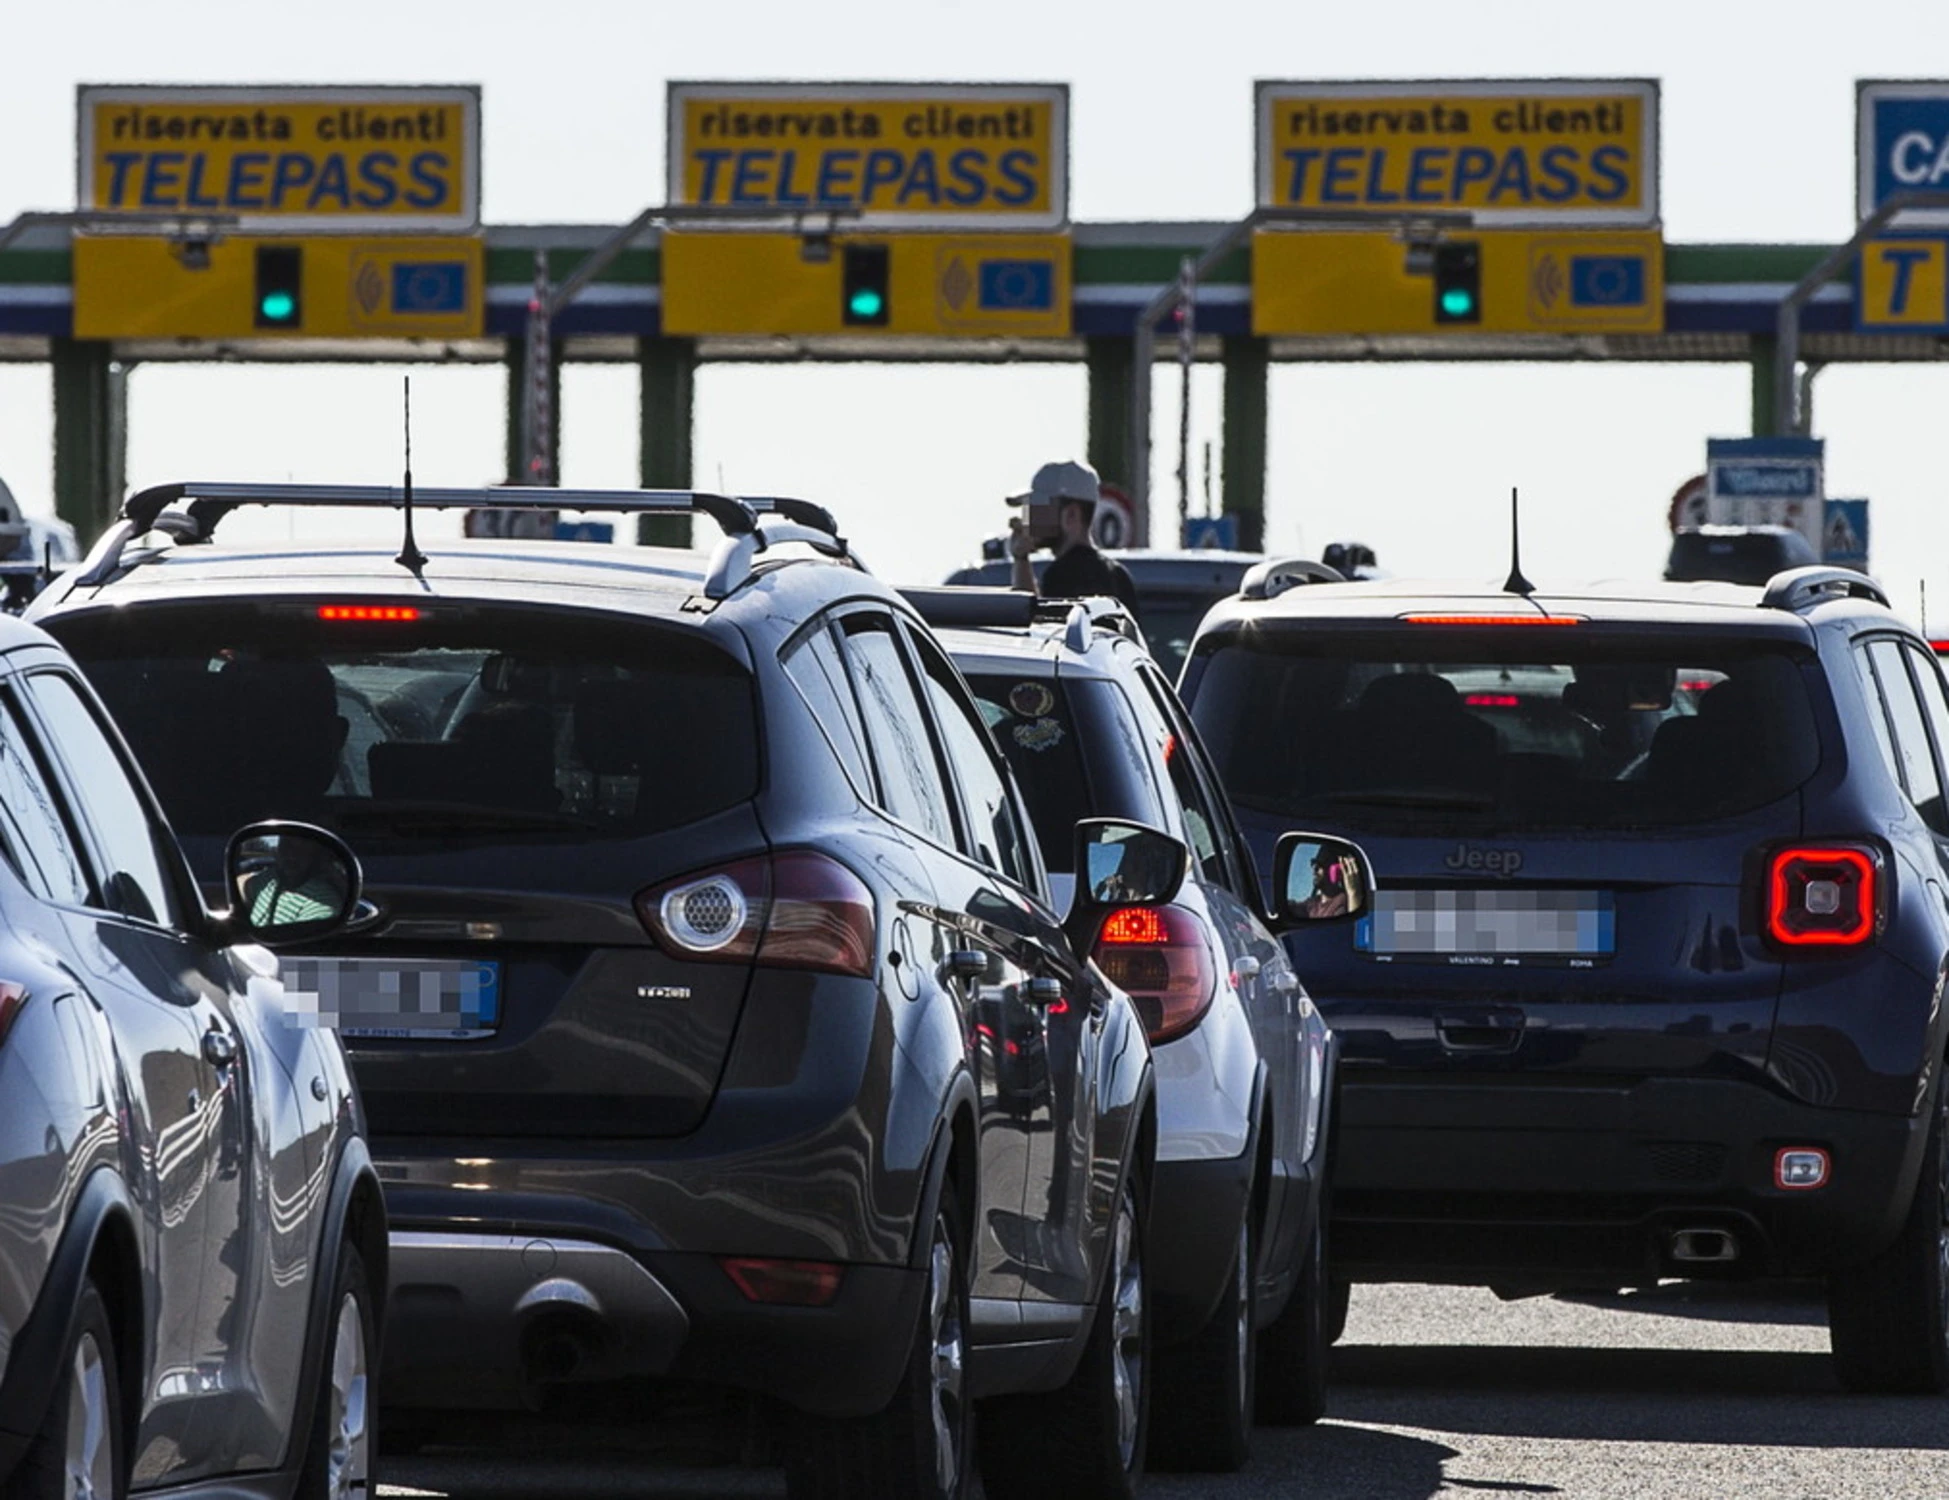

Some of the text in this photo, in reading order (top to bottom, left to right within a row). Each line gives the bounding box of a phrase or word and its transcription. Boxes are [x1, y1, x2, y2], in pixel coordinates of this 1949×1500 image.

[113, 106, 447, 141] riservata clienti
[701, 104, 1034, 139] riservata clienti
[1290, 102, 1623, 136] riservata clienti
[104, 152, 449, 210] TELEPASS
[692, 147, 1038, 207] TELEPASS
[1282, 145, 1630, 203] TELEPASS
[1881, 249, 1932, 317] T
[1446, 844, 1522, 873] Jeep
